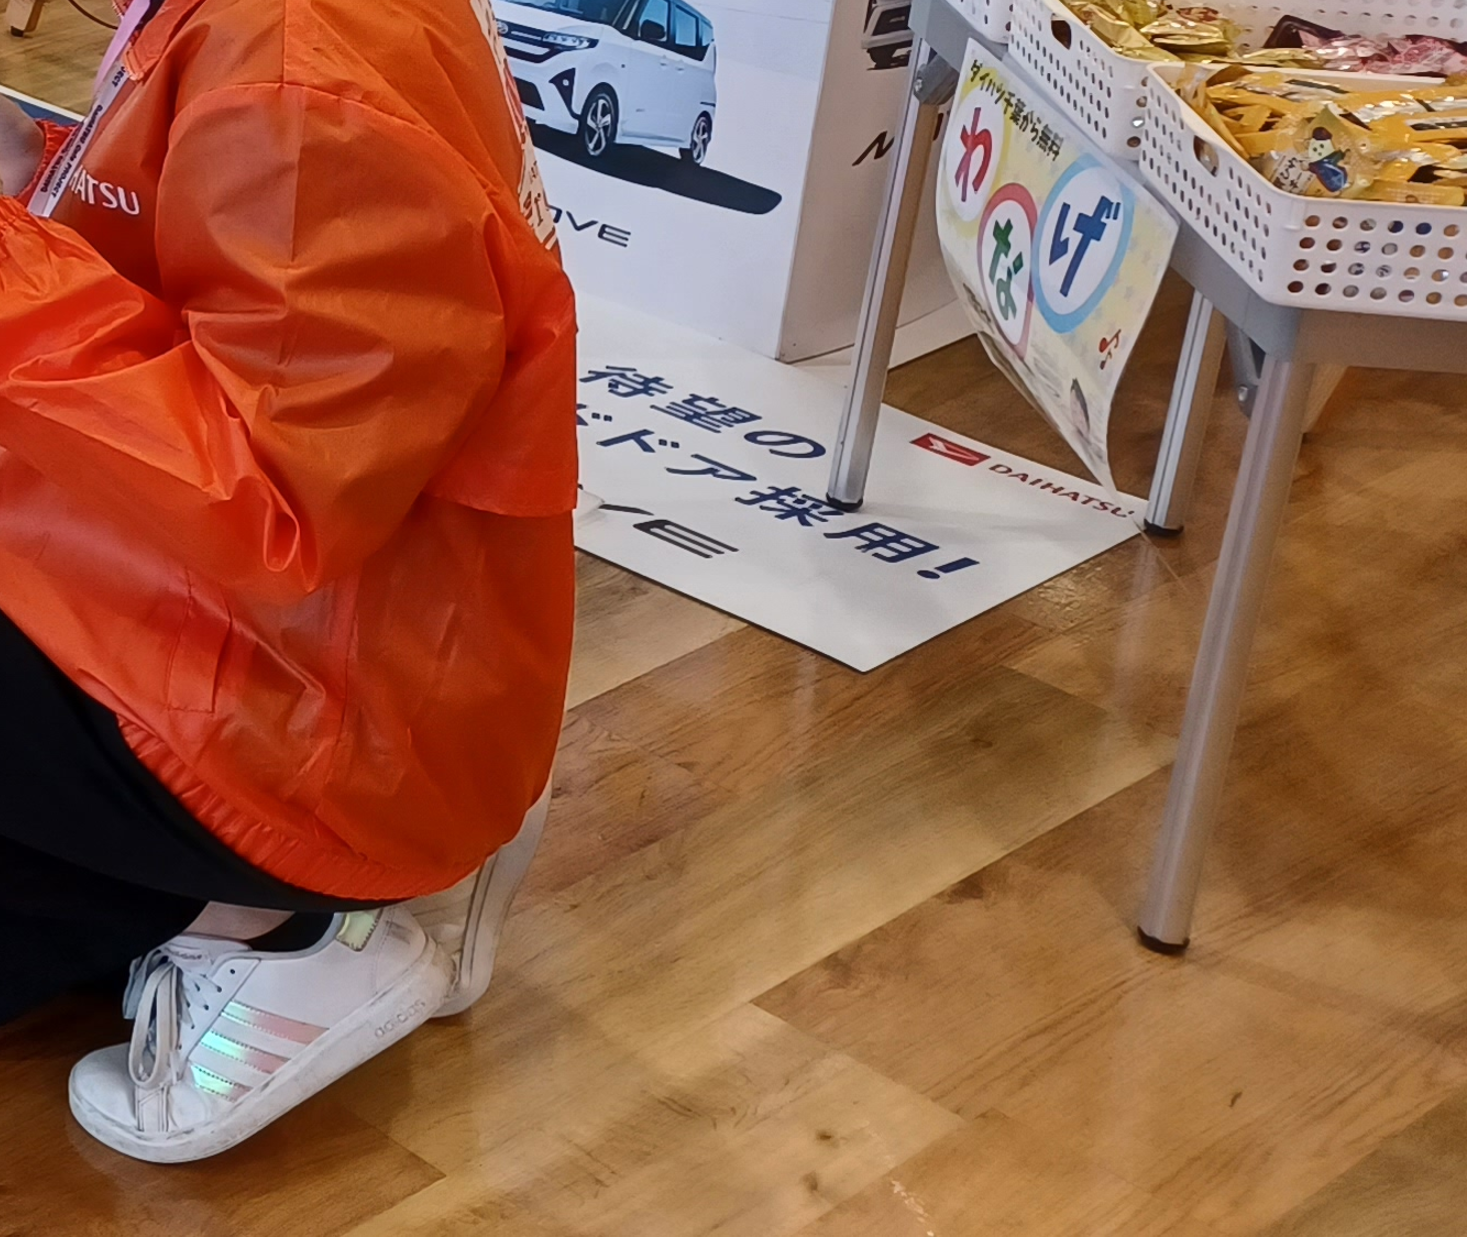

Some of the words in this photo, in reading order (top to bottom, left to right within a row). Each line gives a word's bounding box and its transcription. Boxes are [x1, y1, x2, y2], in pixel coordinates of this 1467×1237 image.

[579, 365, 826, 459] 待望の
[987, 461, 1135, 521] DAIHATSU
